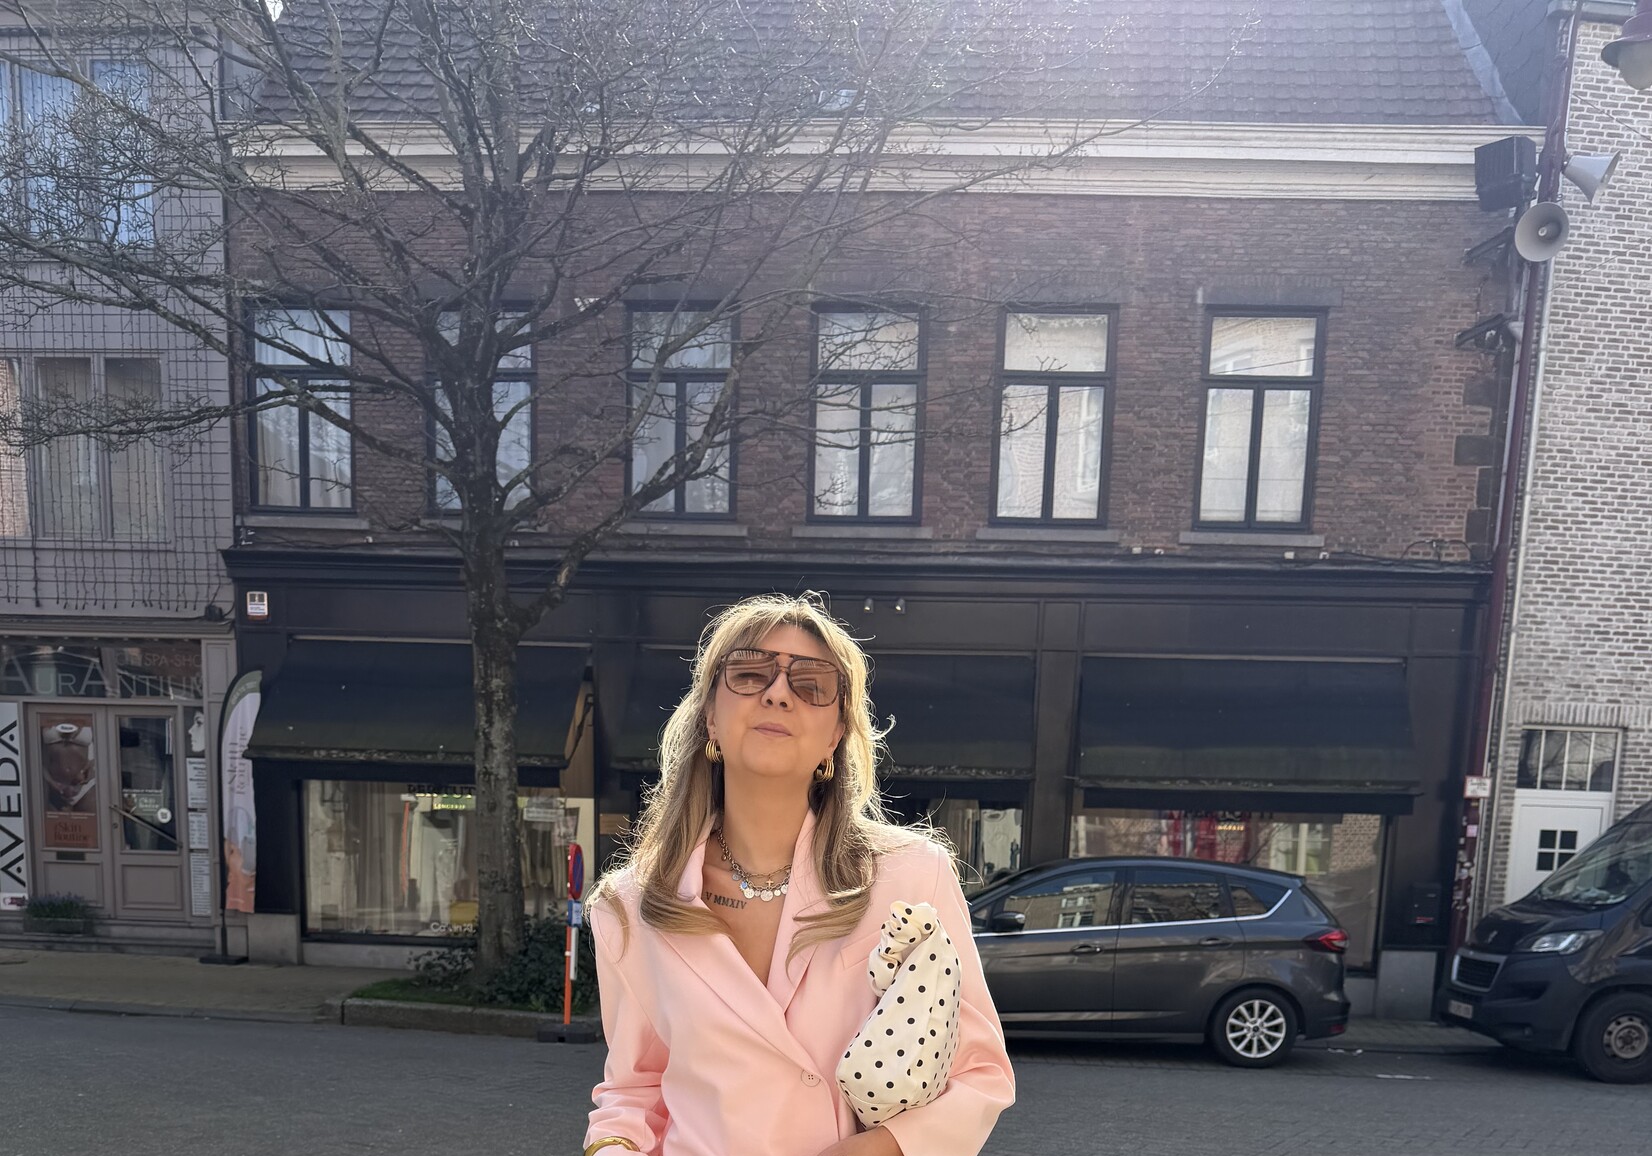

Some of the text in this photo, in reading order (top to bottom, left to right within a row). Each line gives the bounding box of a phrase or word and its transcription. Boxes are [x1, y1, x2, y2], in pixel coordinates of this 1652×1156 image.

[0, 719, 27, 888] AVEDA
[705, 891, 747, 910] V MMXIV
